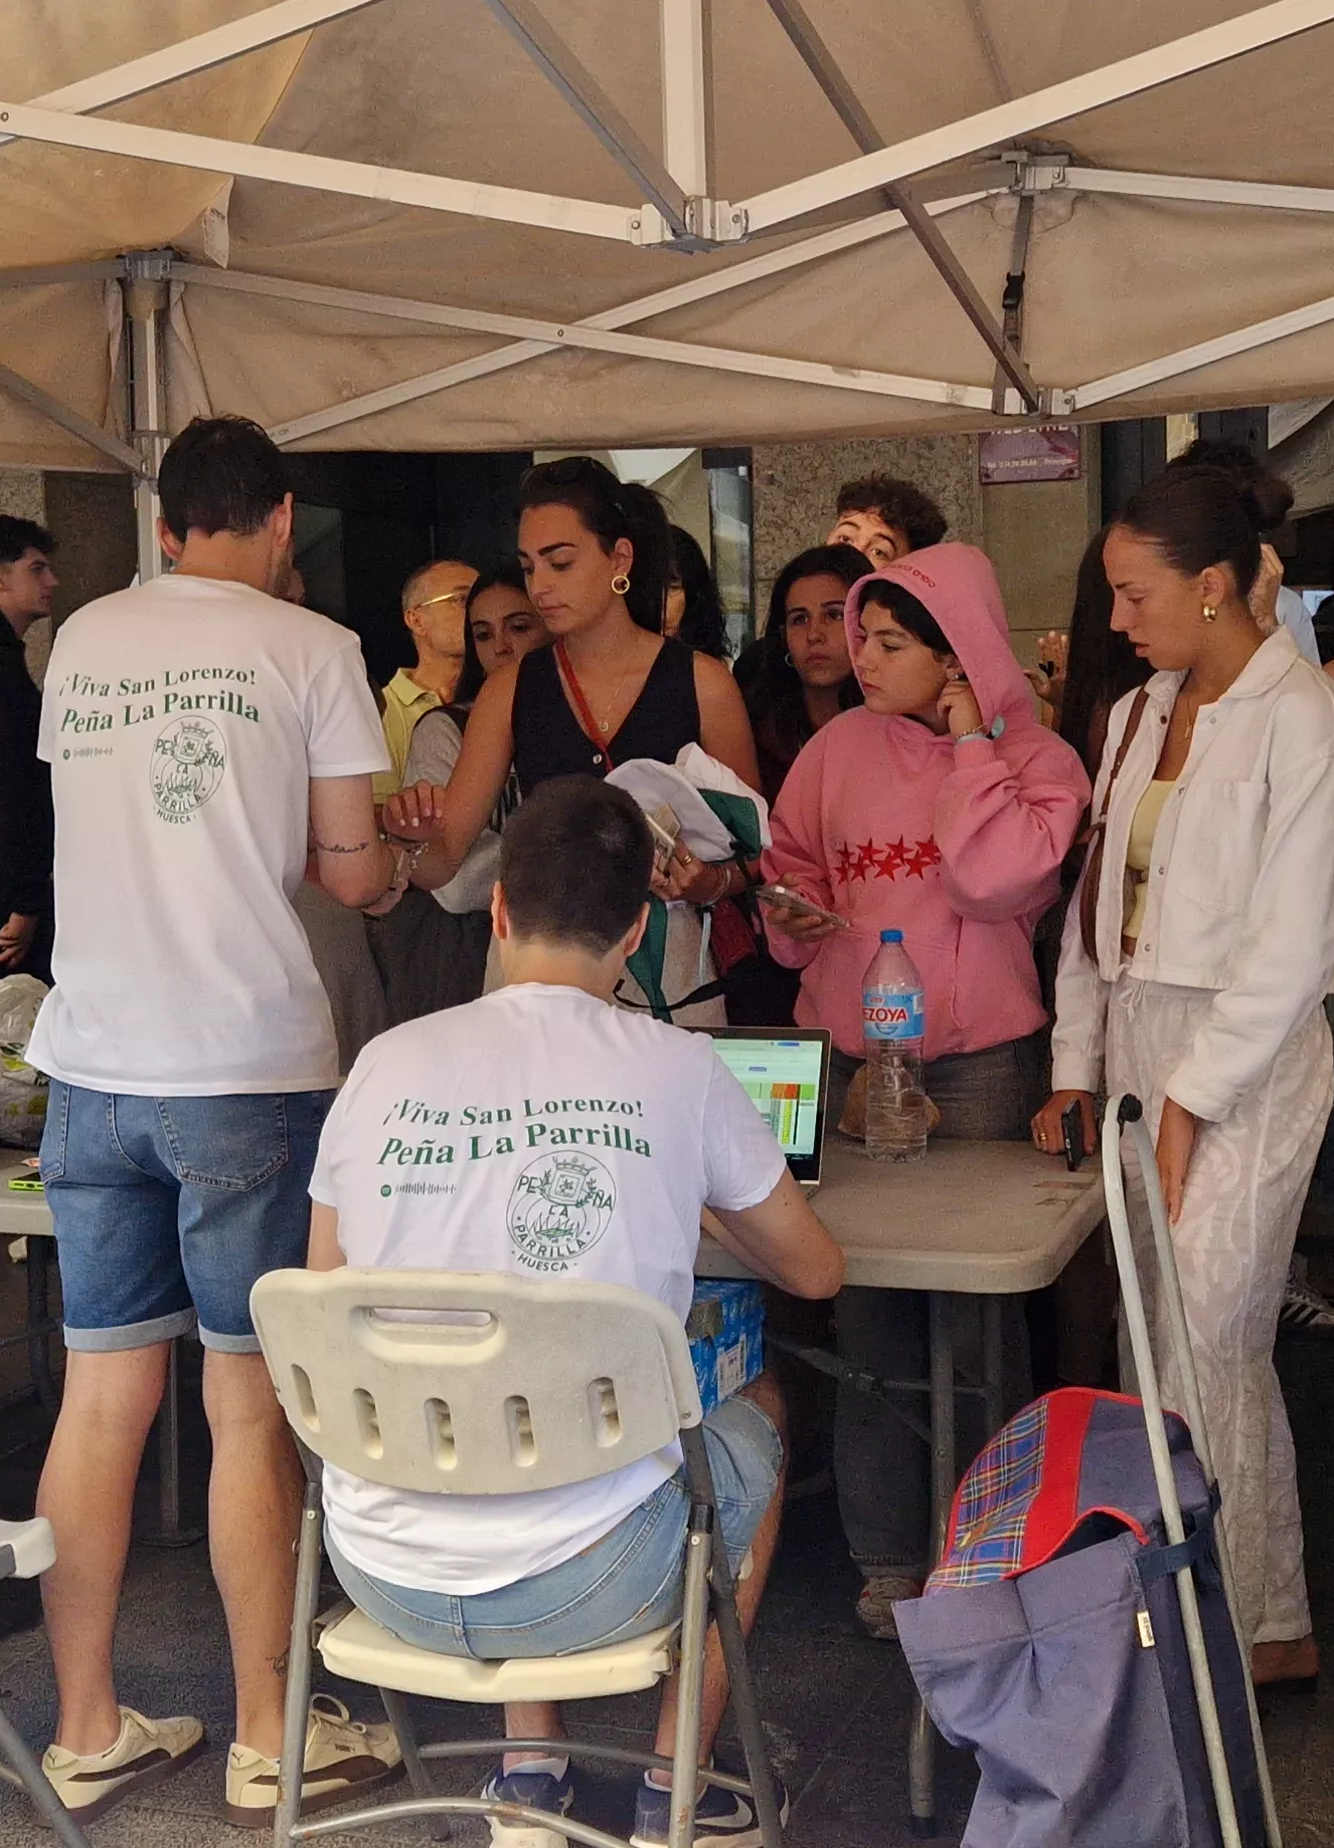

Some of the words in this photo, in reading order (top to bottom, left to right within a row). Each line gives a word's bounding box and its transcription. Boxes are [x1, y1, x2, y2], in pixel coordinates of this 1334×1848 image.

[59, 673, 110, 697] ¡Viva
[117, 678, 156, 697] San
[164, 667, 256, 687] Lorenzo!
[60, 708, 114, 734] Peña
[122, 702, 155, 726] La
[163, 690, 260, 723] Parrilla
[154, 782, 202, 811] PARRILLA
[156, 809, 191, 824] HUESCA
[382, 1099, 450, 1126] ¡Viva
[460, 1105, 512, 1126] San
[523, 1099, 644, 1118] Lorenzo!
[376, 1137, 455, 1166] Peña
[468, 1134, 515, 1161] La
[525, 1123, 652, 1157] Parrilla
[548, 1204, 569, 1218] LA
[515, 1224, 587, 1258] PARRILLA
[517, 1253, 569, 1272] HUESCA
